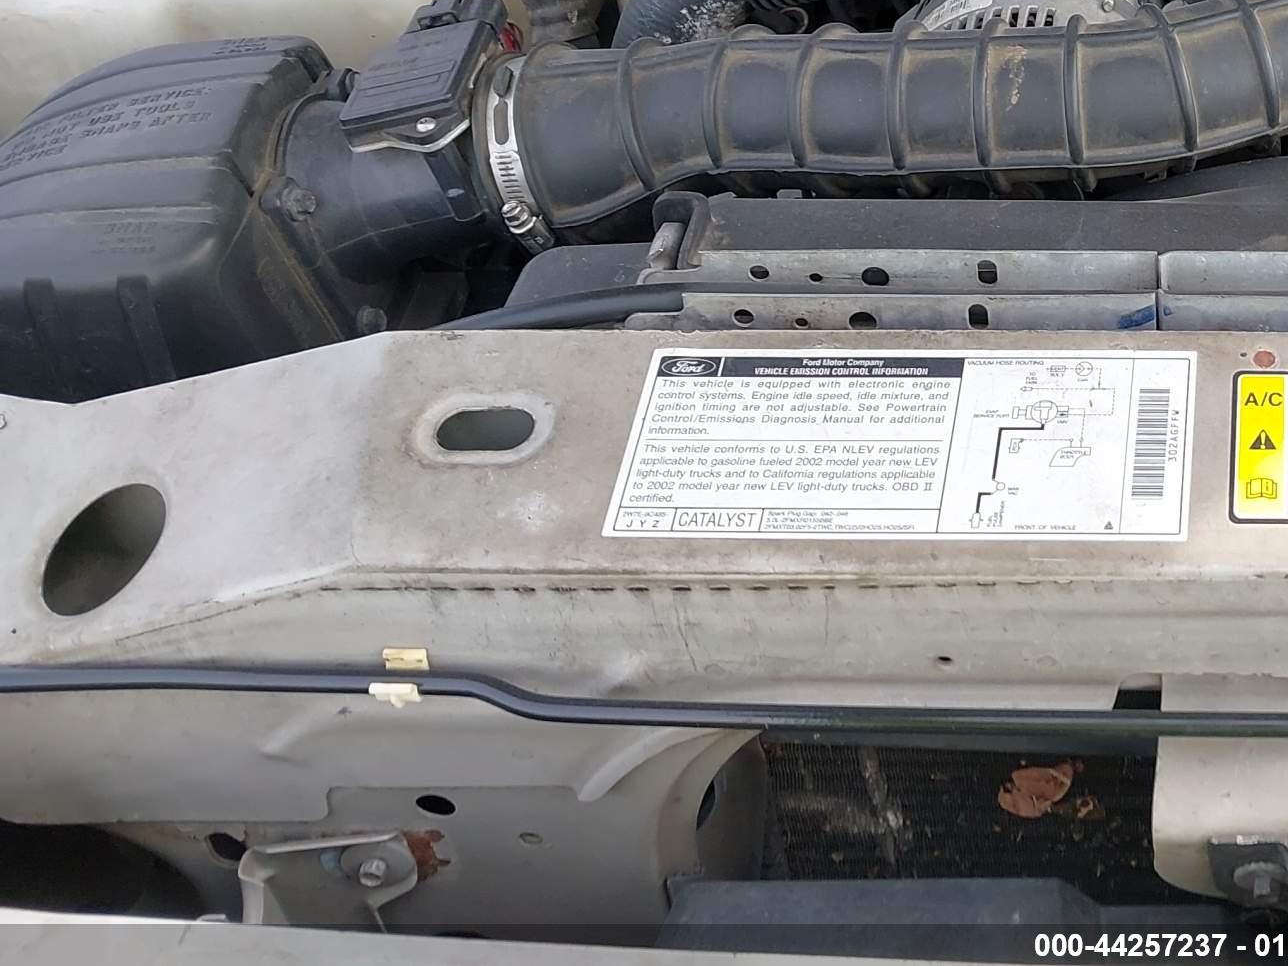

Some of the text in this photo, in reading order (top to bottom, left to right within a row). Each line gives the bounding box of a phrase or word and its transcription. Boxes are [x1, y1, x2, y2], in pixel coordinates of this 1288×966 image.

[672, 361, 706, 373] Ford
[847, 359, 885, 367] Company
[790, 368, 830, 376] EMISSION
[662, 380, 685, 388] This
[693, 380, 734, 388] vehicle
[741, 380, 750, 388] is
[757, 380, 810, 390] equipped
[849, 381, 904, 389] electronic
[912, 381, 950, 390] engine
[658, 391, 695, 399] control
[699, 392, 746, 401] systems.
[752, 392, 788, 401] Engine
[793, 392, 812, 400] idle
[816, 392, 852, 401] speed,
[880, 393, 924, 401] mixture,
[1244, 392, 1282, 406] A/C
[654, 403, 696, 412] ignition
[702, 403, 736, 413] timing
[790, 403, 852, 413] adjustable.
[857, 403, 880, 412] See
[886, 403, 947, 412] Powertrain
[651, 414, 945, 425] Control/Emissions Diagnosis Manual for additional
[648, 426, 710, 435] information.
[644, 444, 940, 456] This vehicle conforms to U.S. EPA NLEV regulations
[639, 457, 695, 467] applicable
[698, 458, 708, 466] to
[710, 457, 756, 467] gasoline
[759, 458, 792, 466] fueled
[795, 458, 823, 466] 2002
[825, 458, 859, 466] model
[861, 459, 886, 468] year
[915, 458, 938, 466] LEV
[636, 469, 935, 480] light-duty trucks and to California regulations applicable
[632, 482, 643, 490] to
[646, 482, 675, 490] 2002
[678, 482, 712, 490] model
[715, 484, 740, 492] year
[770, 482, 794, 491] LEV
[797, 482, 848, 493] light-duty
[852, 482, 887, 491] trucks.
[892, 482, 919, 491] OBD
[629, 494, 675, 503] certified.
[626, 520, 660, 528] J Y Z
[678, 512, 757, 528] CATALYST
